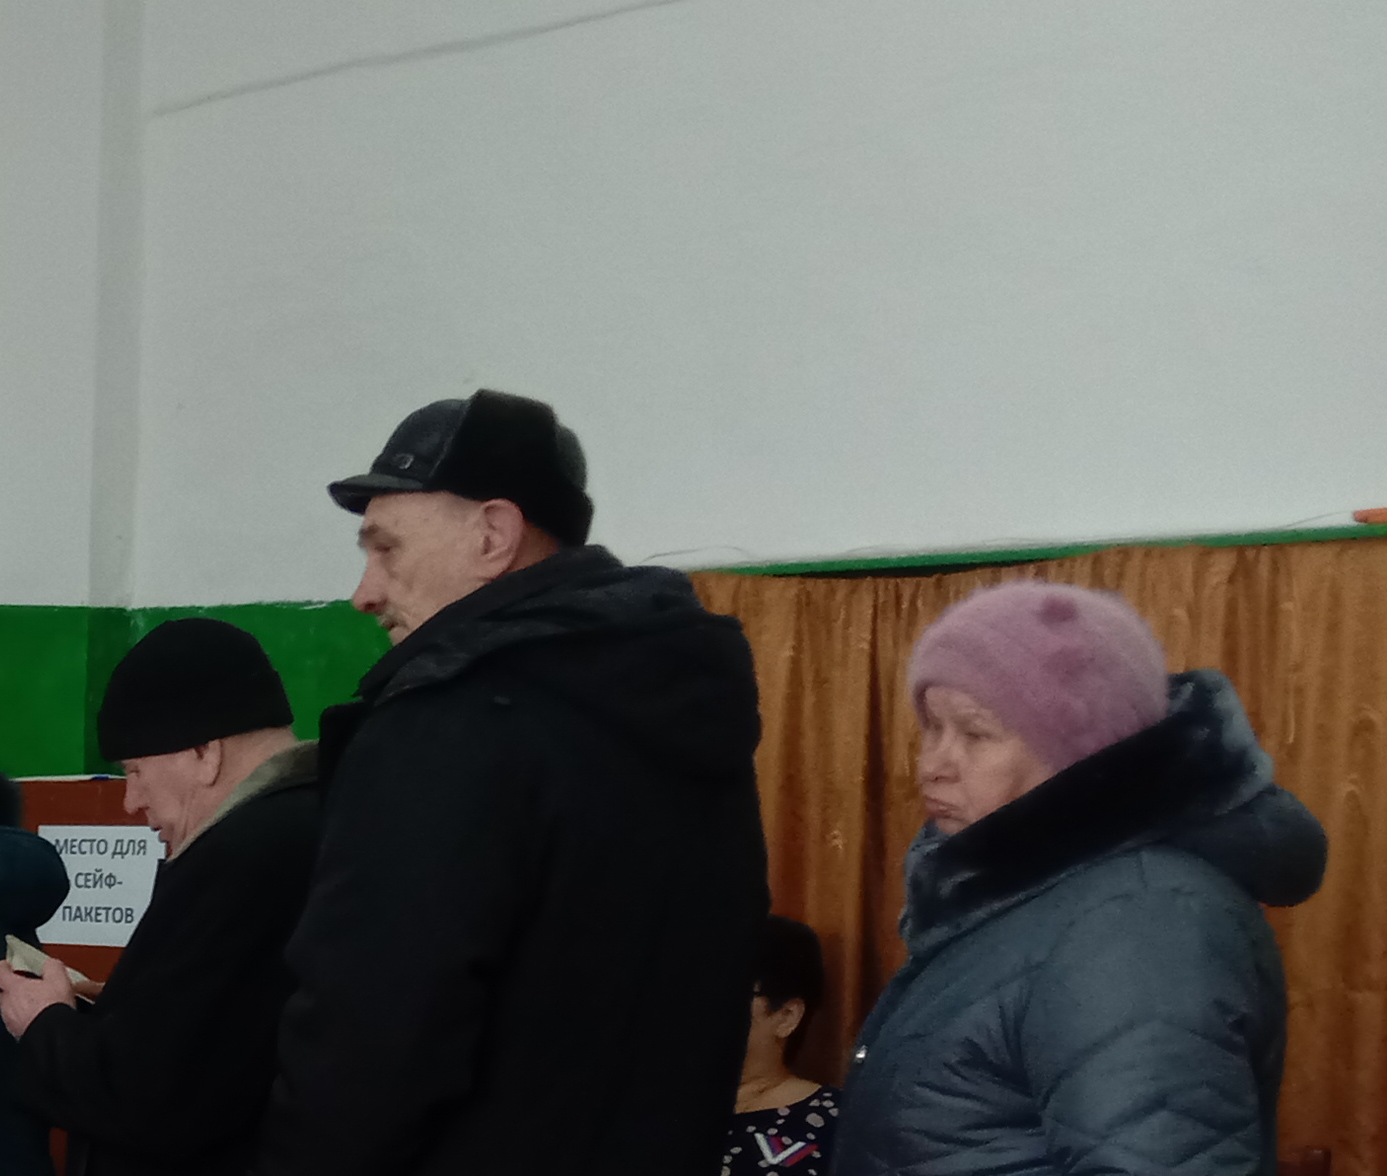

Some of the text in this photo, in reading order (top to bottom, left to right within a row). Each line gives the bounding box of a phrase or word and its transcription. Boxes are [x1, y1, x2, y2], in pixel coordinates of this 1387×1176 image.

[55, 838, 147, 859] МЕСТО ДЛЯ
[74, 868, 123, 889] СЕЙФ-
[62, 905, 134, 924] ПАКЕТОВ
